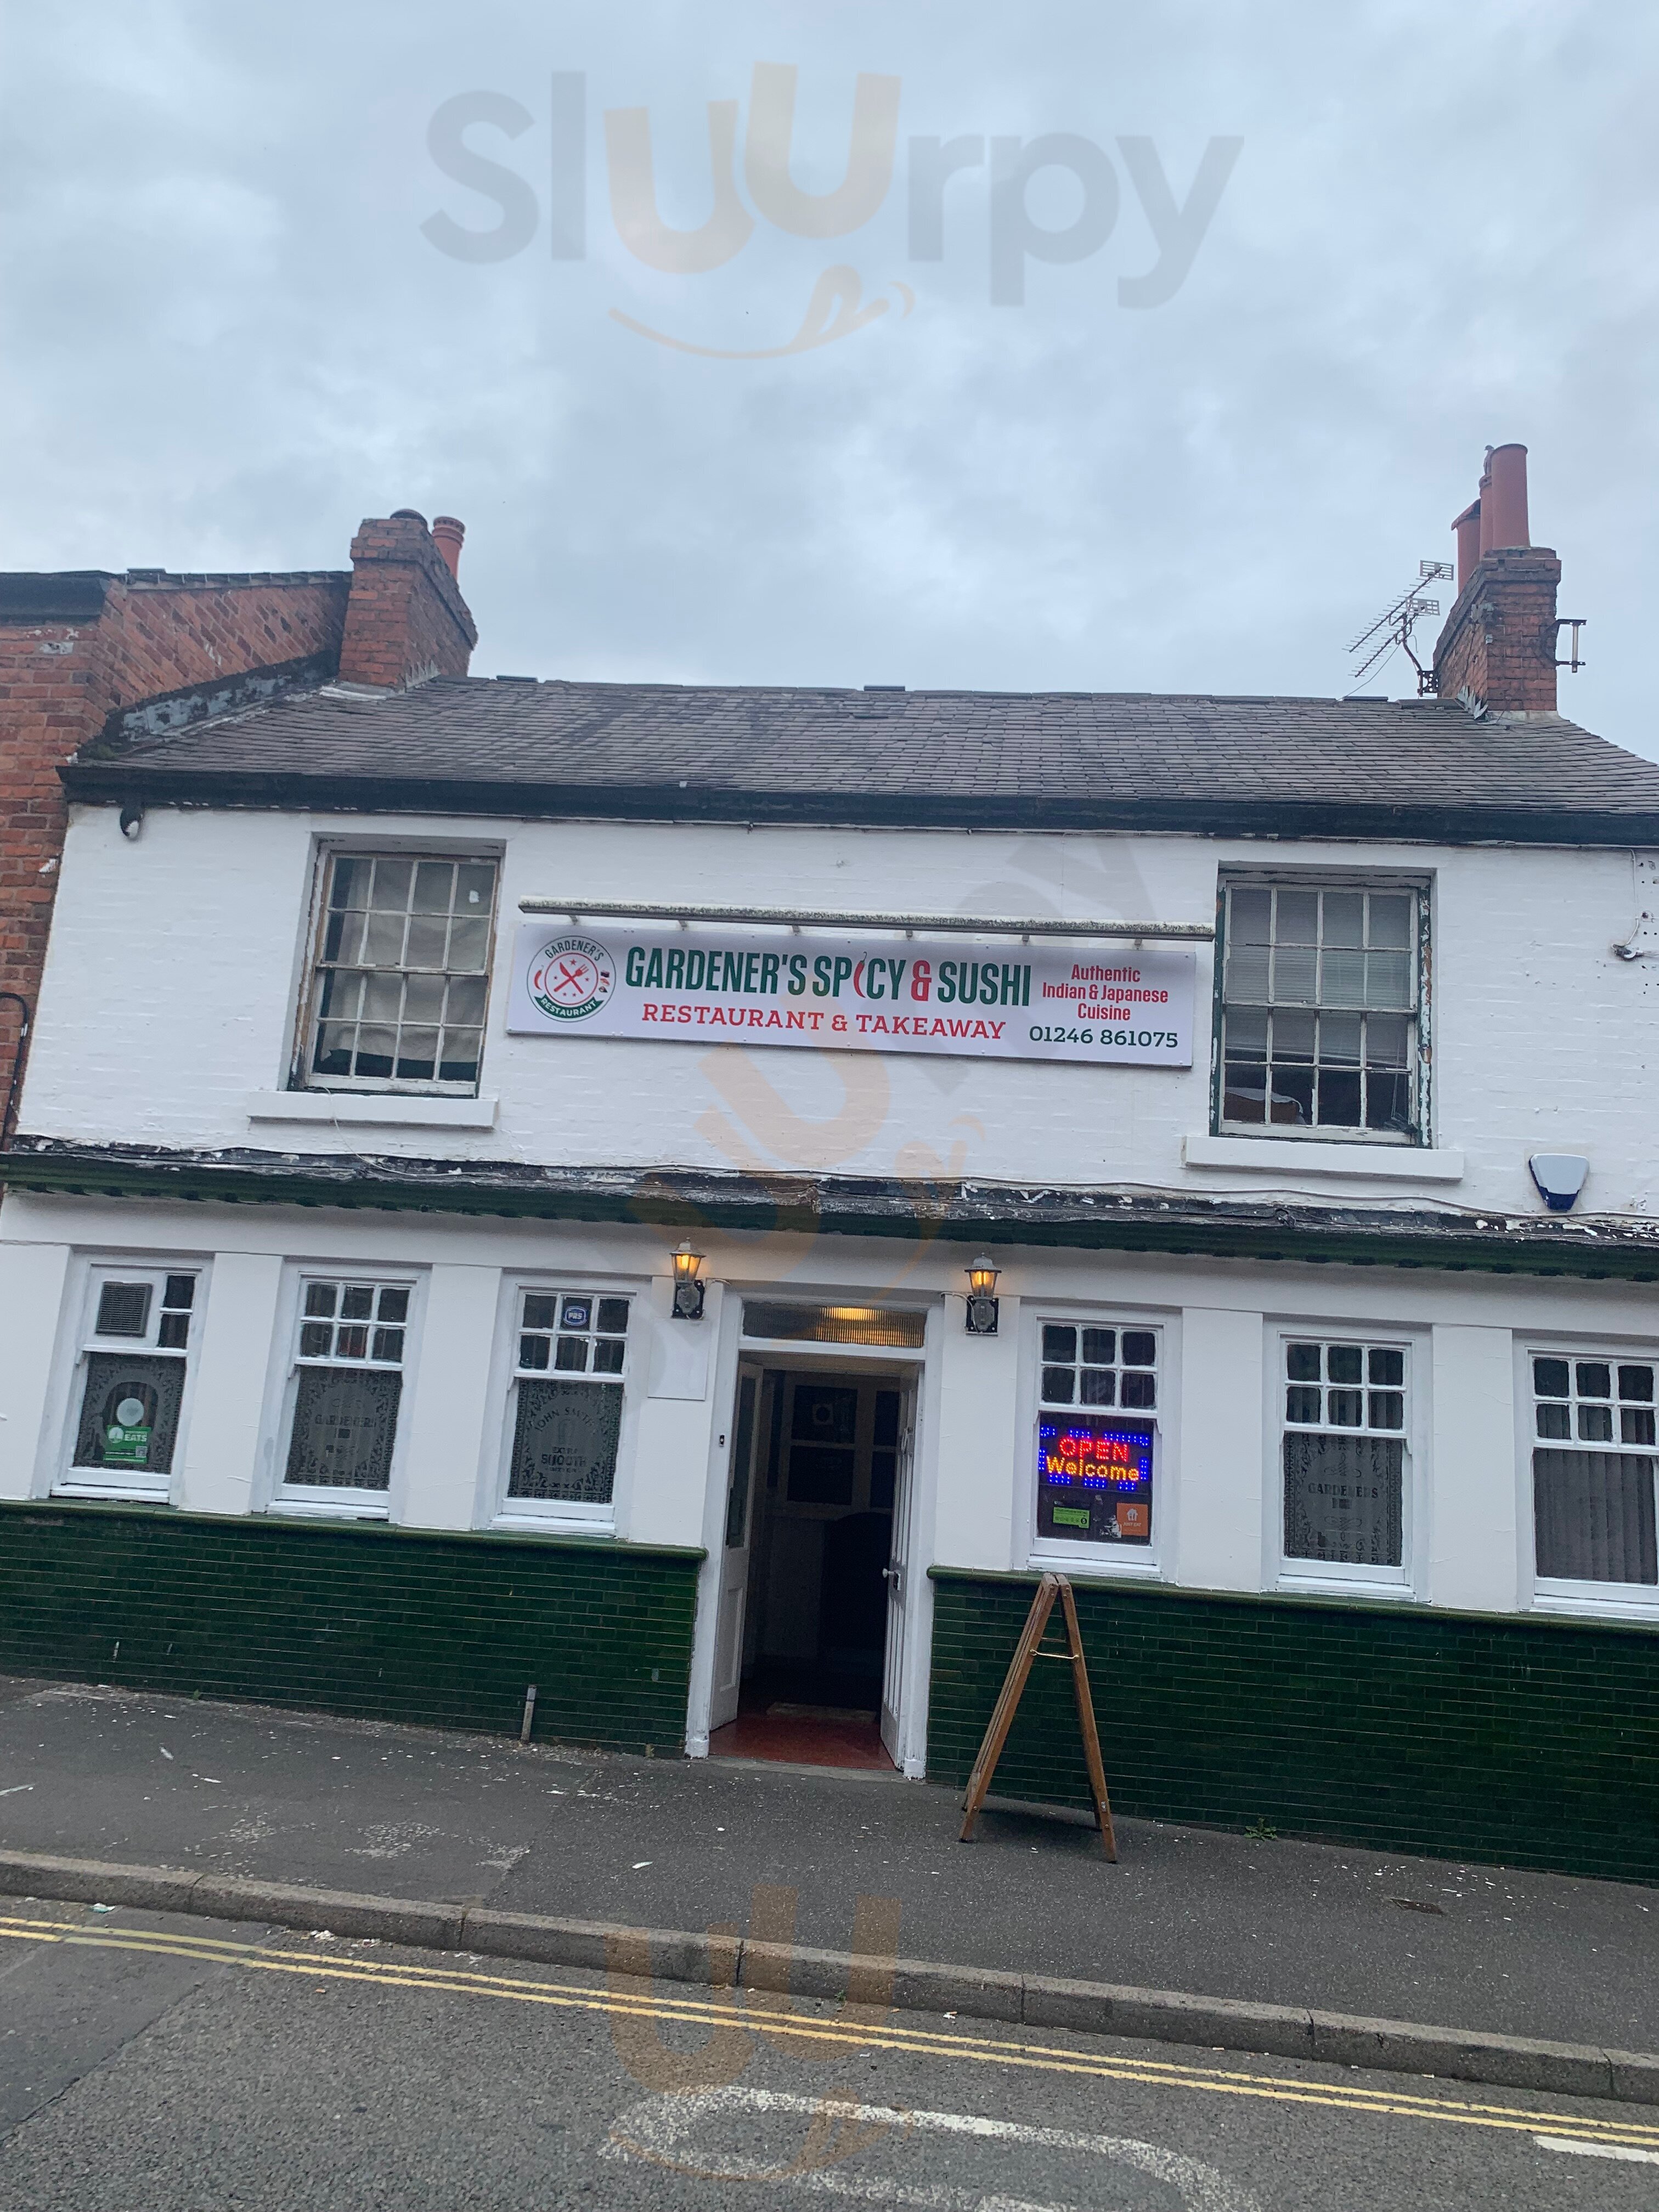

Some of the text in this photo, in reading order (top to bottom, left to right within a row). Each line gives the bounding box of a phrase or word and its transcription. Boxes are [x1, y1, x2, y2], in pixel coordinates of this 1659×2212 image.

[545, 939, 604, 961] GARDENER'S
[625, 946, 808, 995] GARDENER'S
[911, 960, 932, 1002] &
[938, 961, 1031, 1006] SUSHI
[1071, 964, 1141, 983] Authentic
[1042, 982, 1169, 1004] Indian & Japanese
[541, 997, 596, 1016] RESTAURANT
[1077, 1003, 1131, 1021] Cuisine
[642, 1003, 1006, 1040] RESTAURANT & TAKEAWAY
[1029, 1025, 1178, 1048] 01246 861075
[1059, 1438, 1128, 1463] OPEN
[1046, 1455, 1140, 1481] Welcome
